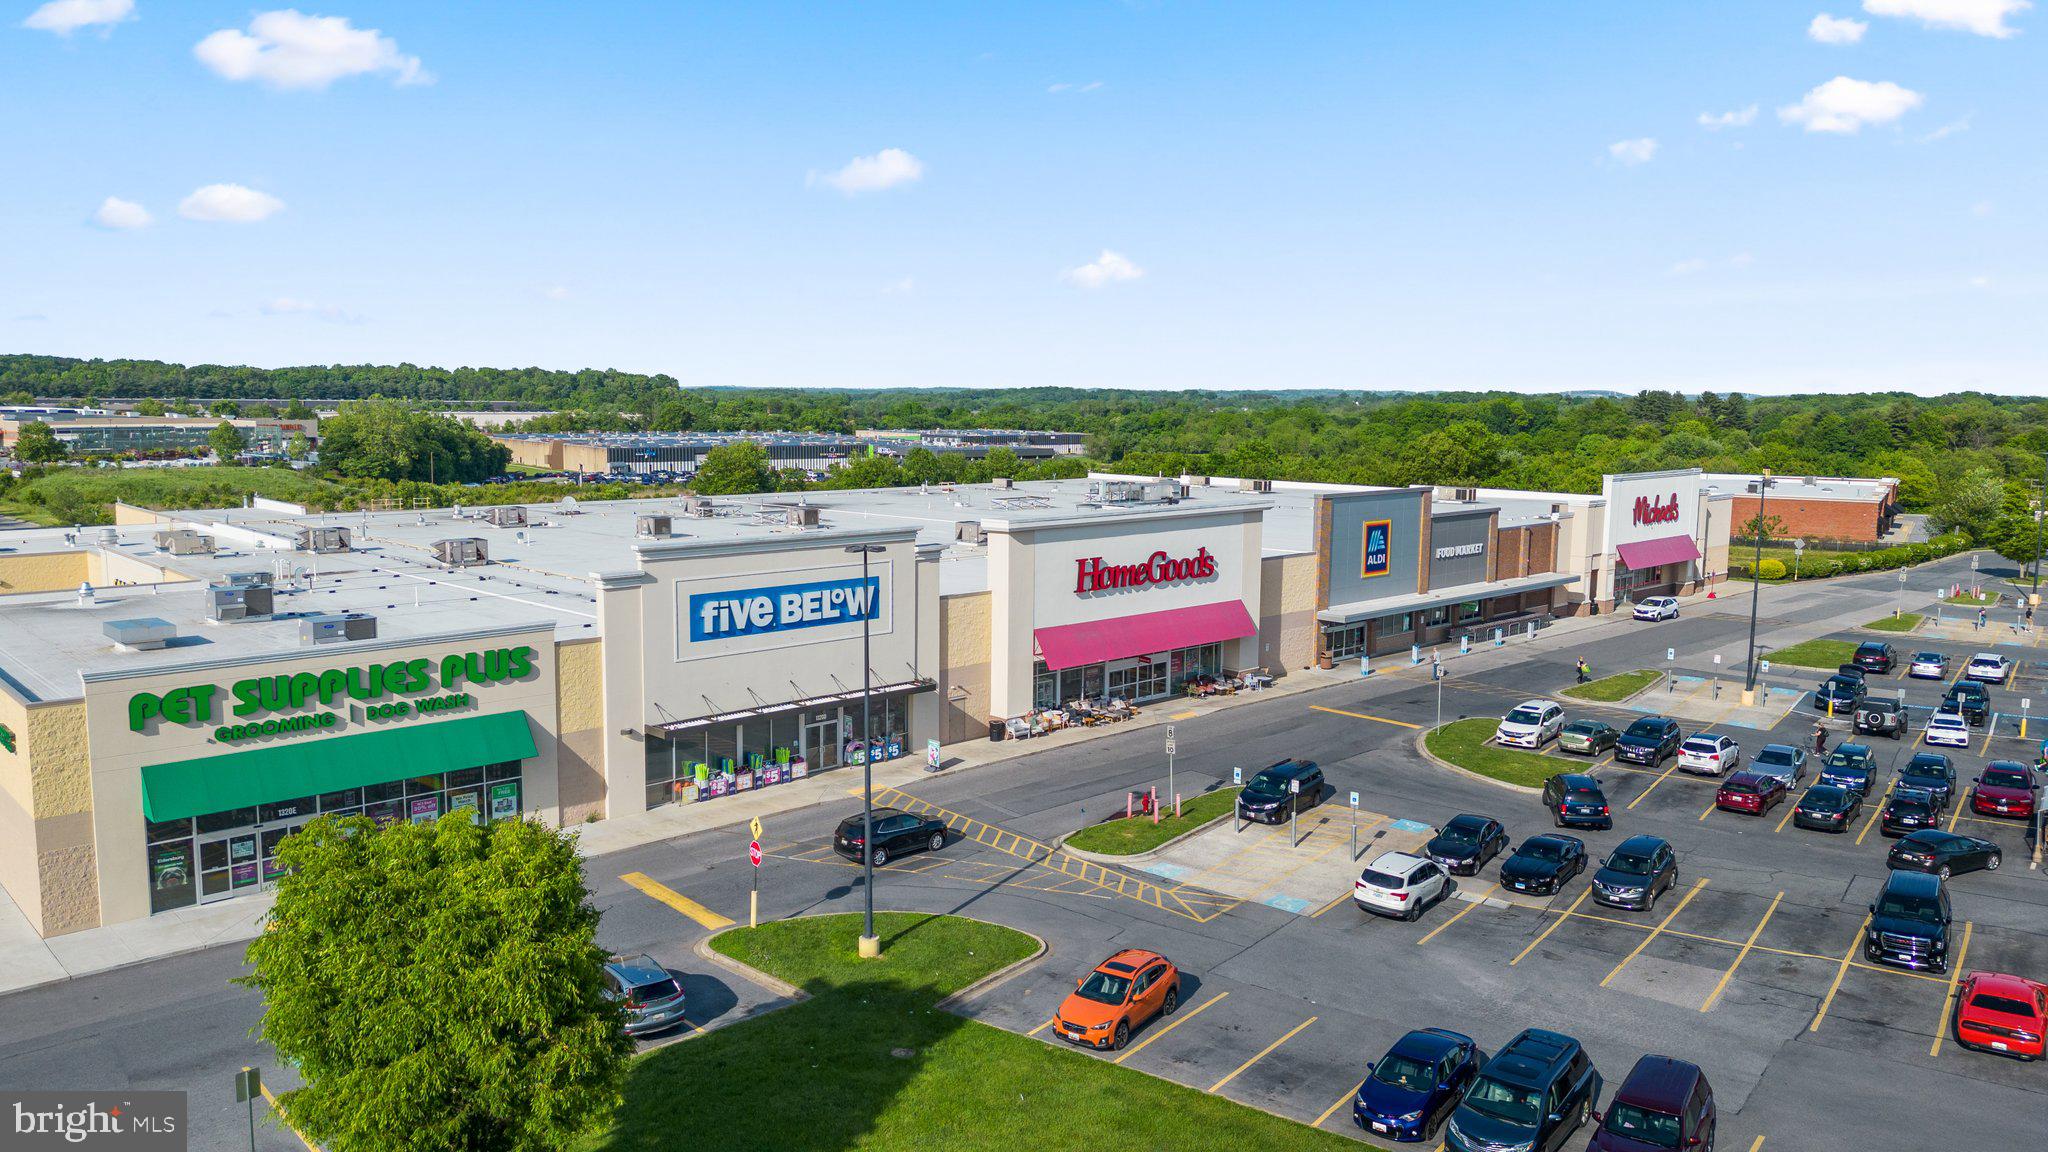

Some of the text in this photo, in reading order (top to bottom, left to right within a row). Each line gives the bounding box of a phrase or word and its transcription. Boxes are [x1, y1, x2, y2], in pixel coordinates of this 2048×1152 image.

[1633, 493, 1679, 526] Michaels
[1367, 554, 1386, 565] ALDI
[1436, 543, 1483, 559] FOOD MARKET
[1073, 547, 1215, 593] HomeGoods
[701, 586, 875, 634] five BELOW
[129, 646, 532, 731] PET SUPPLIES PLUS
[214, 692, 470, 743] GROOMING DOG WASH
[871, 748, 882, 760] $5
[888, 745, 899, 757] $5
[278, 806, 297, 816] 1320E
